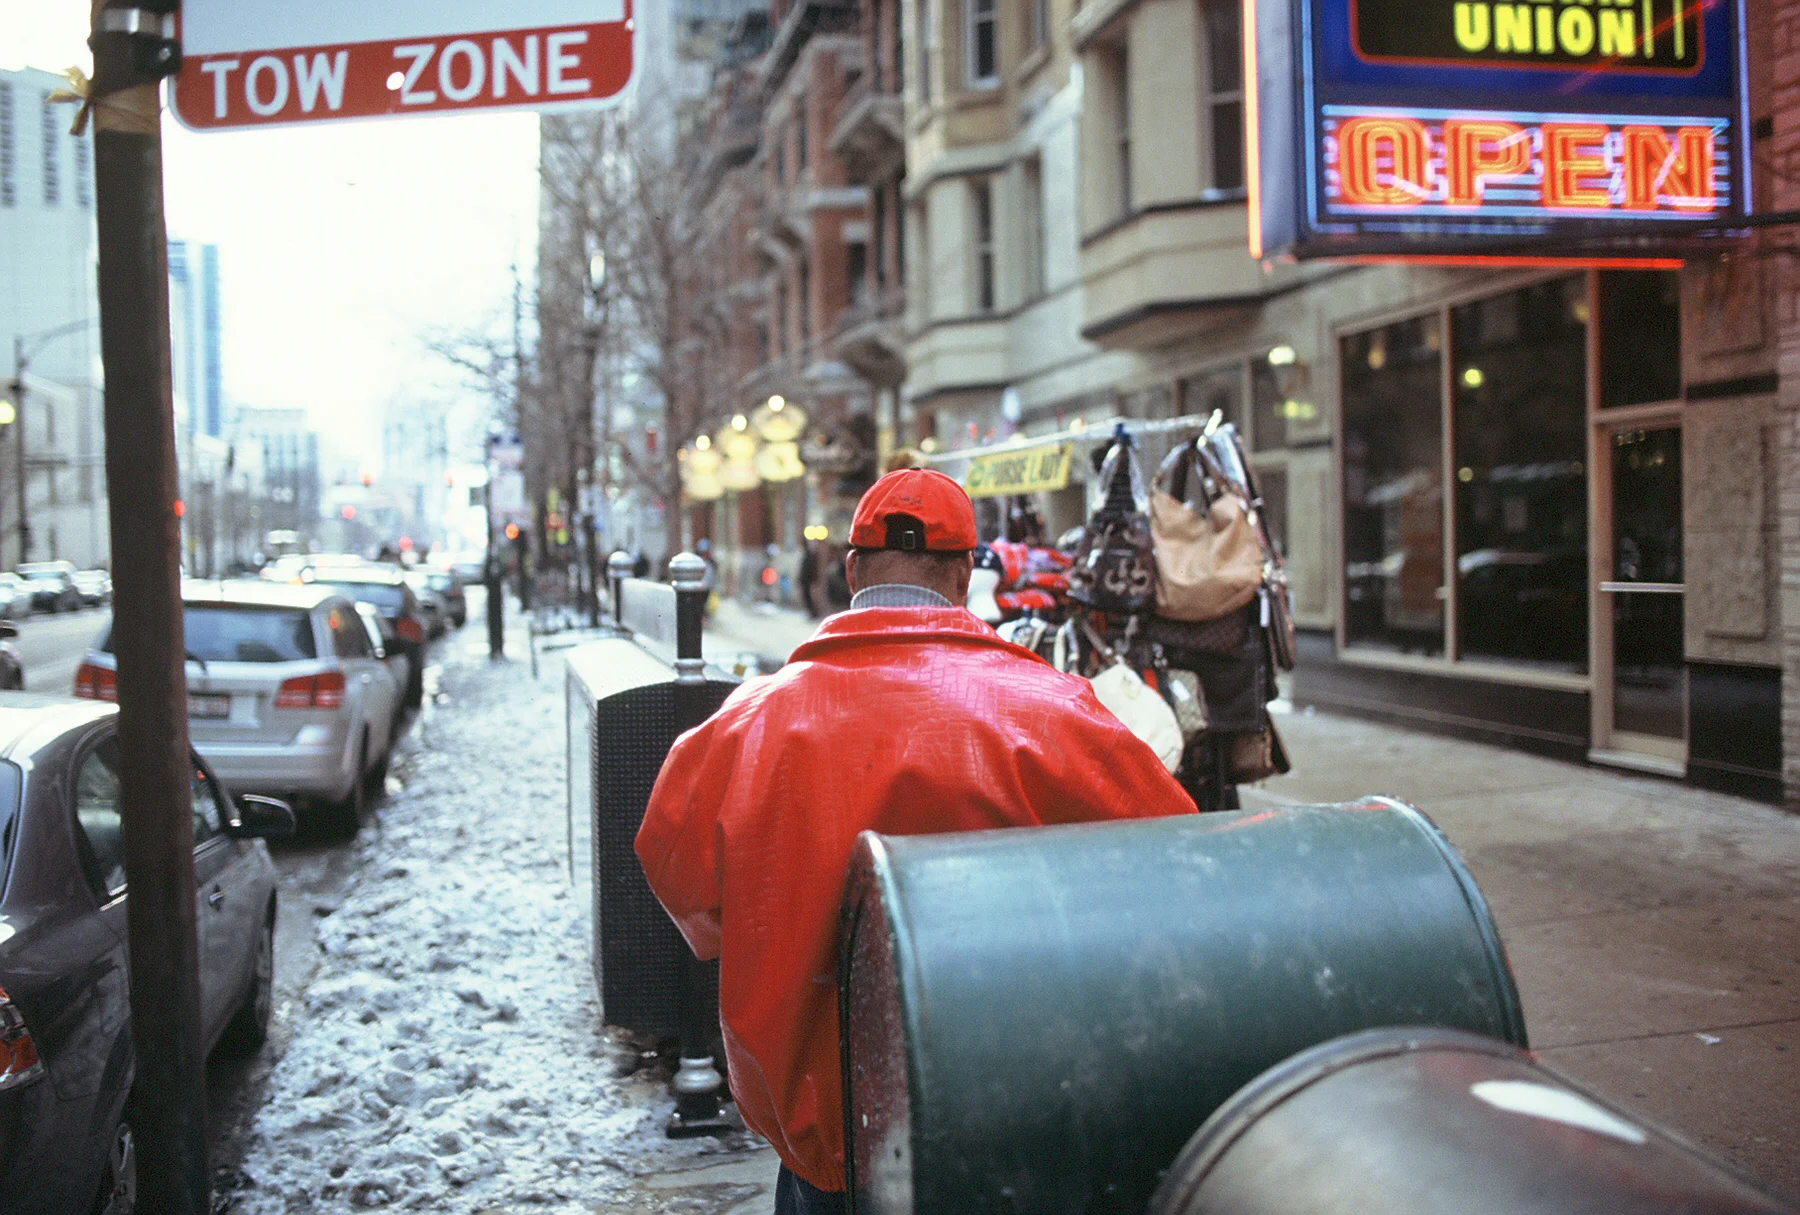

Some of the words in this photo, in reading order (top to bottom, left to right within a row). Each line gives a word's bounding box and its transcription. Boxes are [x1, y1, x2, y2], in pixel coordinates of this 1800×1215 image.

[1454, 4, 1636, 56] UNION
[201, 51, 348, 118] TOW
[393, 31, 591, 104] ZONE
[1338, 117, 1715, 212] OPEN
